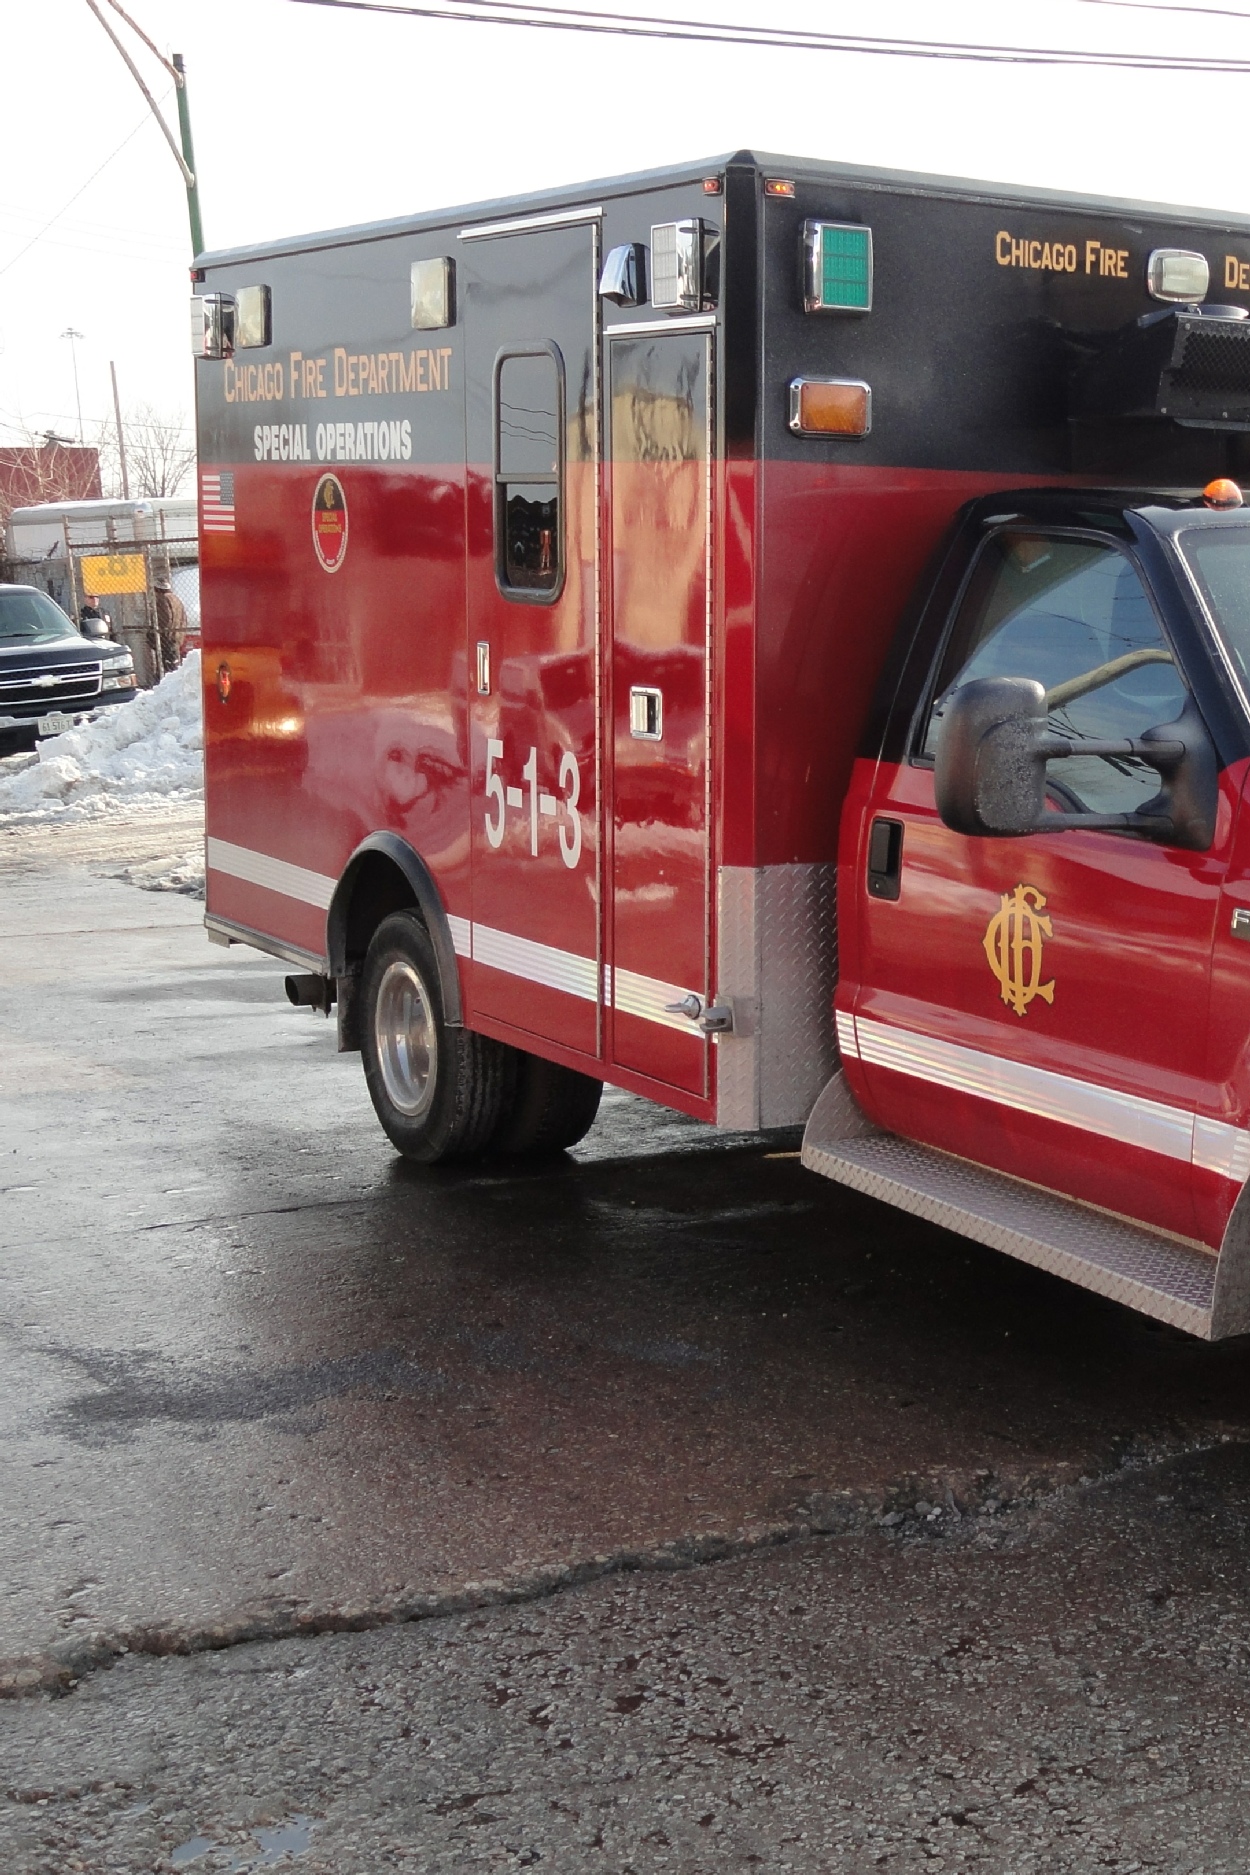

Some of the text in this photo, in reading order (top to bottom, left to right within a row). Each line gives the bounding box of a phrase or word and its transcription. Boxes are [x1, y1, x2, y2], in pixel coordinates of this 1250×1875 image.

[996, 231, 1076, 273] CHICAGO
[1085, 240, 1129, 278] FIRE
[224, 347, 452, 402] CHICAGO FIRE DEPARTMENT
[254, 419, 412, 461] SPECIAL OPERATIONS
[485, 738, 582, 869] 5-1-3
